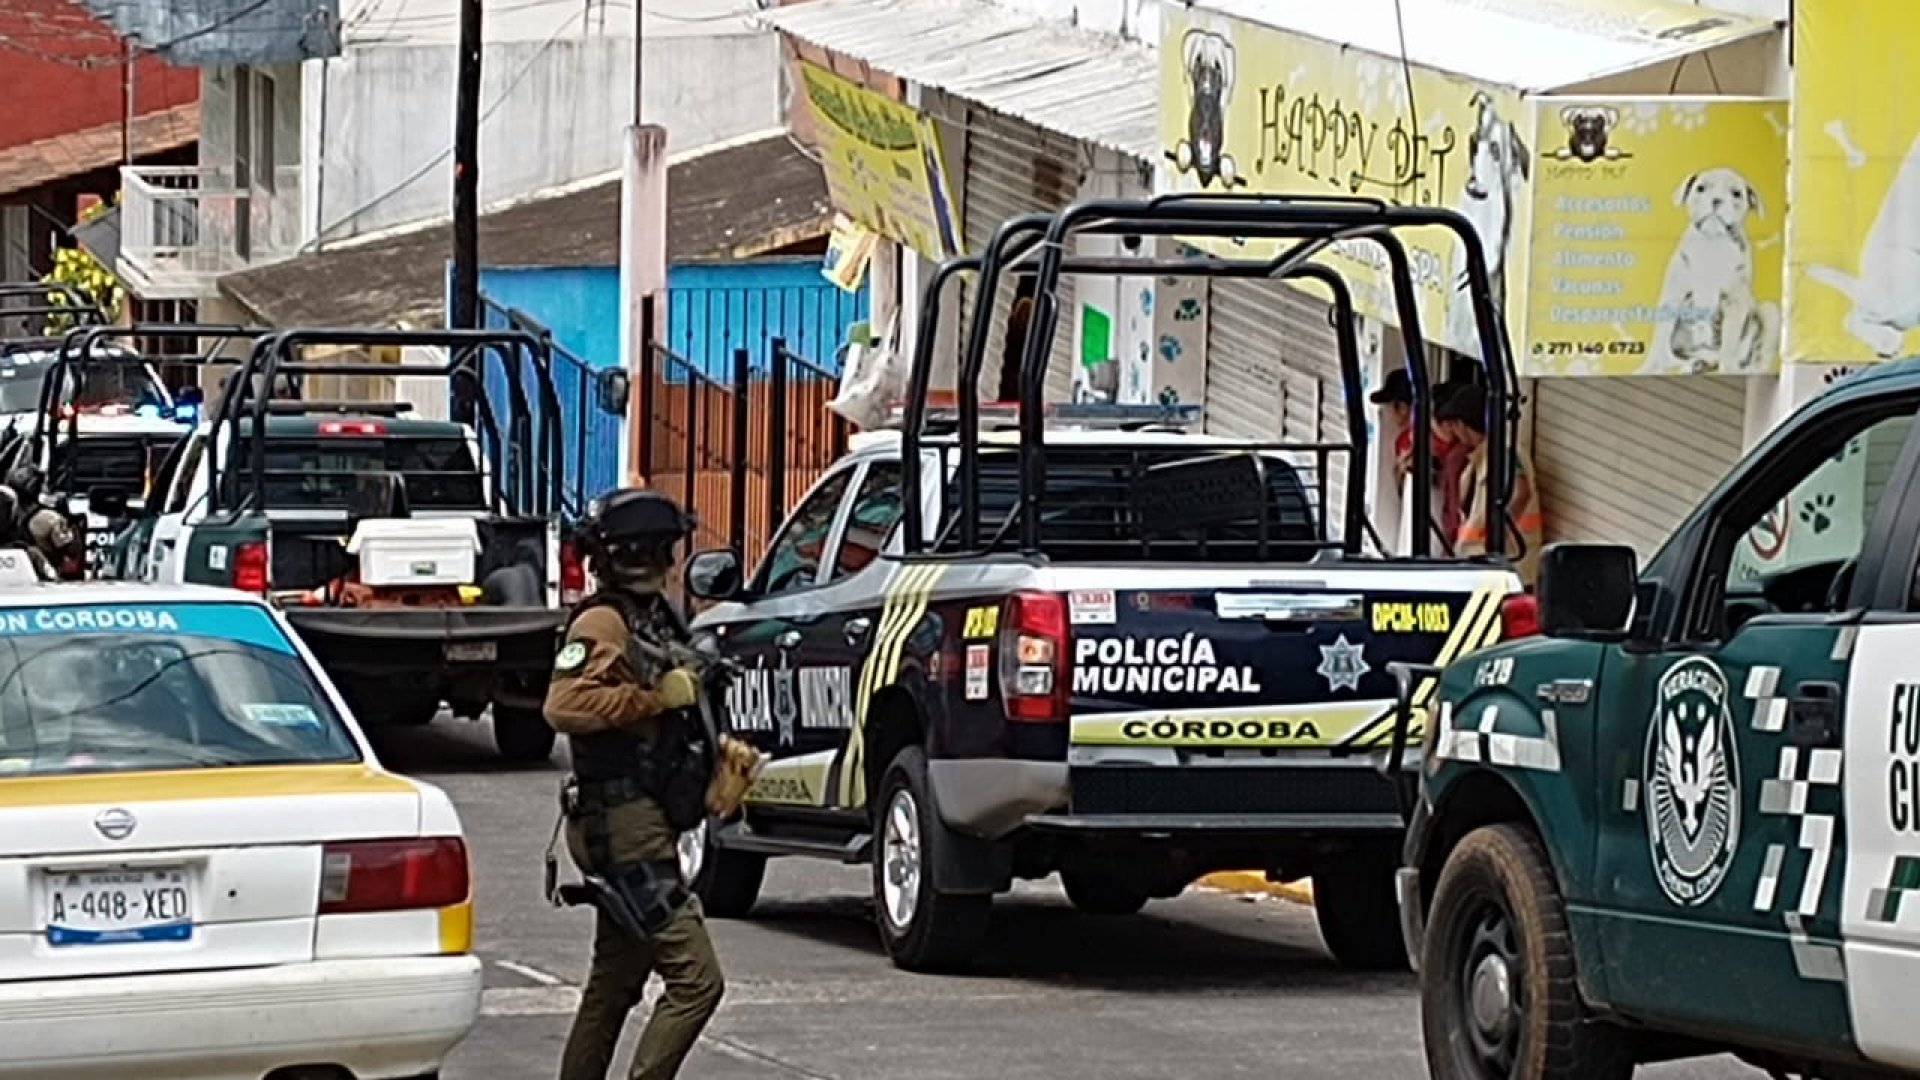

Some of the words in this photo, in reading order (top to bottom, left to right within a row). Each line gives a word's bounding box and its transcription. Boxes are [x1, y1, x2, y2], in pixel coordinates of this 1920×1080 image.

[1255, 84, 1378, 193] HAPPY
[1387, 116, 1455, 207] PET
[1548, 341, 1572, 355] 271
[1577, 341, 1604, 355] 140
[1607, 341, 1645, 355] 6723
[1075, 632, 1216, 665] POLICÍA
[1072, 665, 1261, 694] MUNICIPAL
[1664, 668, 1723, 705] VERACRUZ
[799, 666, 854, 729] MUNICIPAL
[1122, 714, 1320, 739] CÓRDOBA
